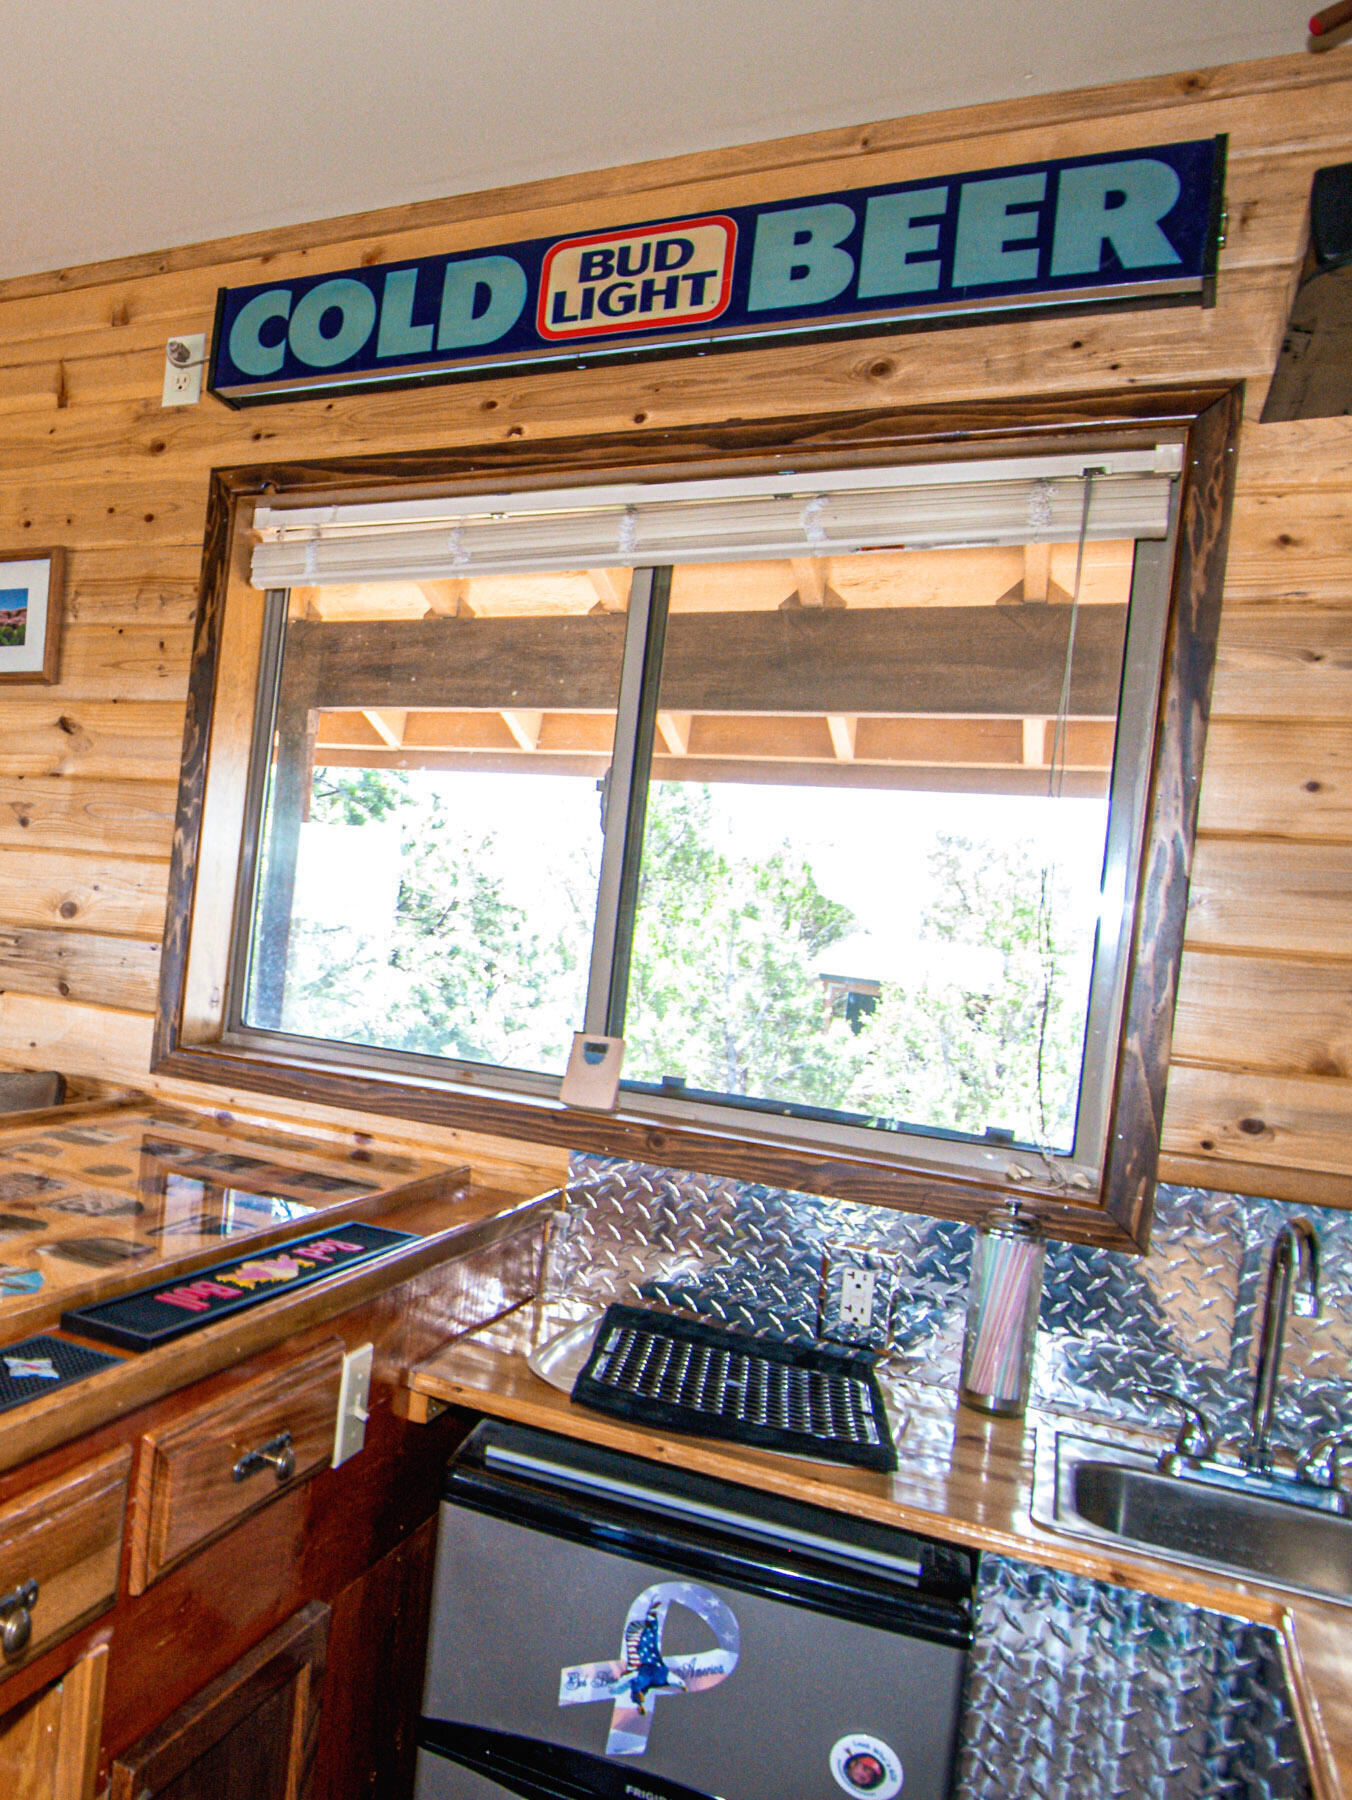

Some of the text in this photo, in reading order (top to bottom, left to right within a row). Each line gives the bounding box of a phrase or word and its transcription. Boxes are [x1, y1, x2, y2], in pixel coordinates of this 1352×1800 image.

[228, 157, 1185, 378] COLD BEER
[578, 237, 695, 284] BUD
[550, 269, 718, 325] LIGHT
[153, 1237, 366, 1312] Red Bull
